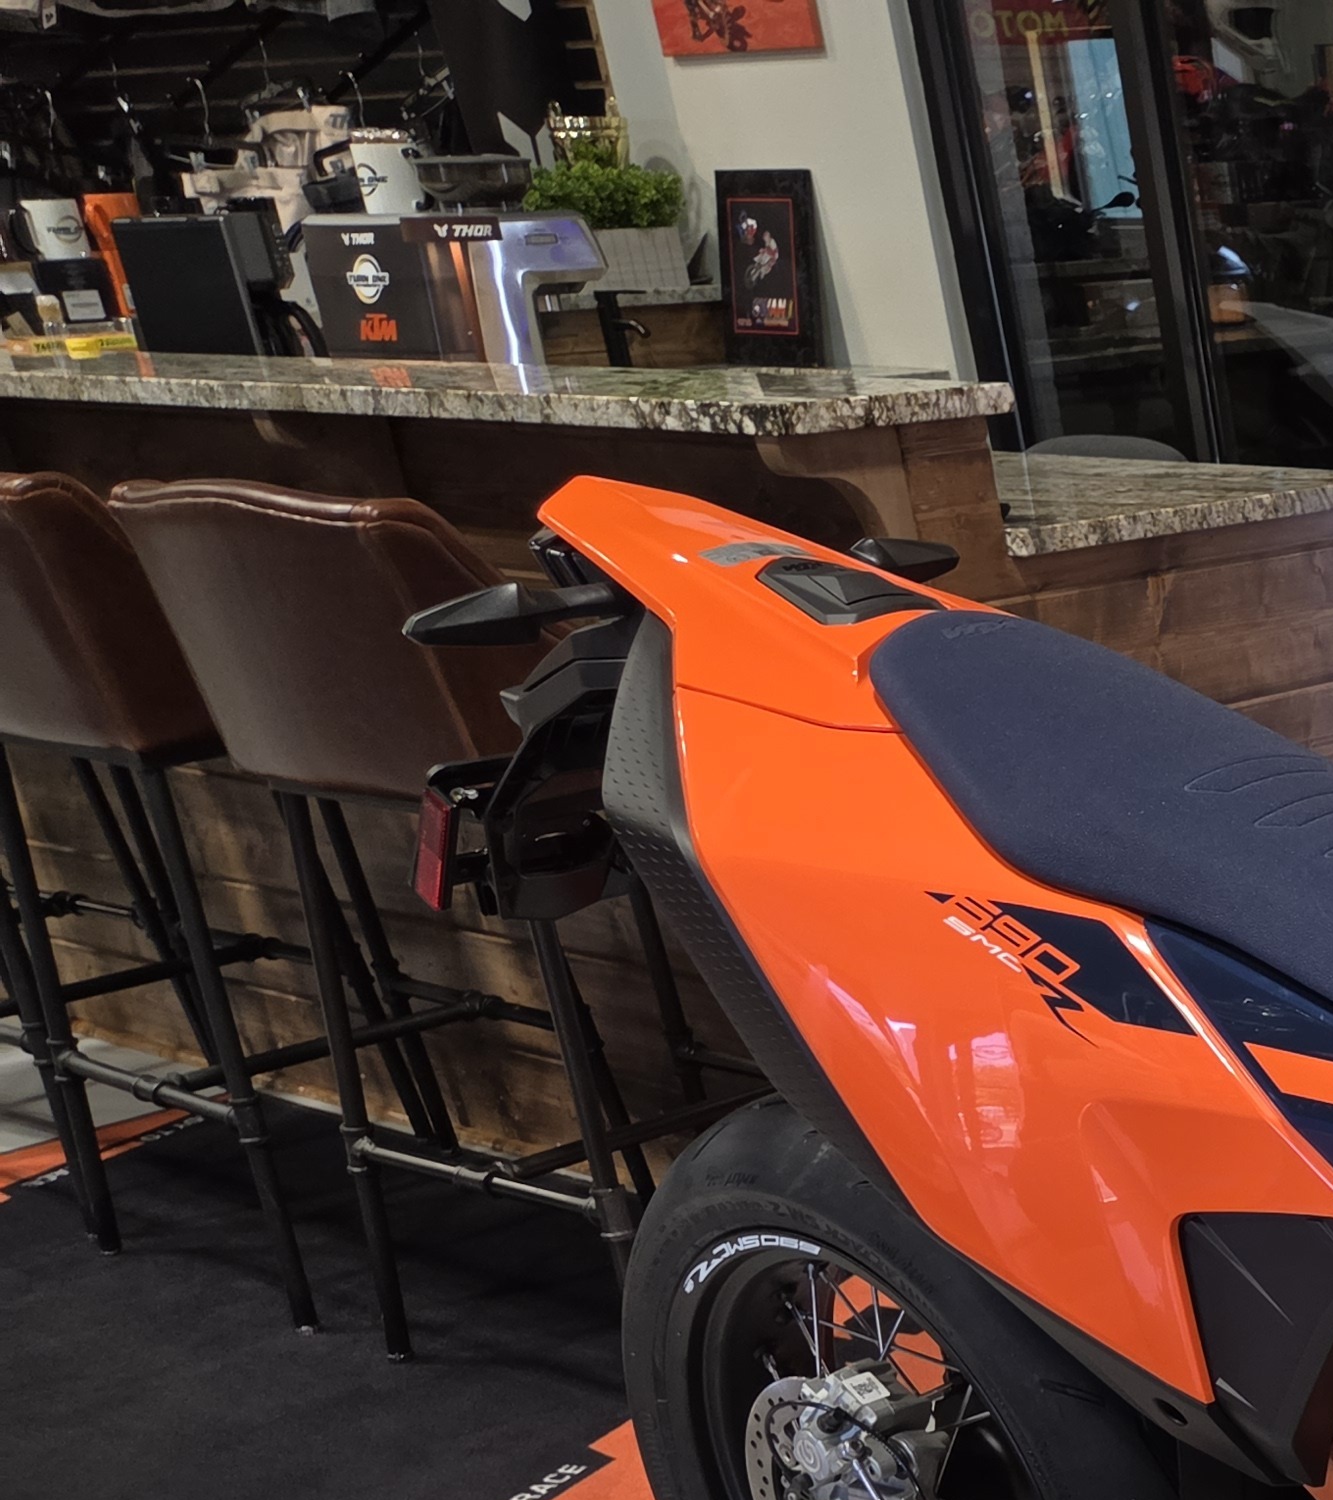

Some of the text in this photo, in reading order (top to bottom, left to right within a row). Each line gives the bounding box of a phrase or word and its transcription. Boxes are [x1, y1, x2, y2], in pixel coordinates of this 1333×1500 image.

[350, 232, 375, 245] THOR
[452, 224, 493, 237] THOR
[360, 313, 398, 341] KTM
[943, 915, 1022, 973] SMC
